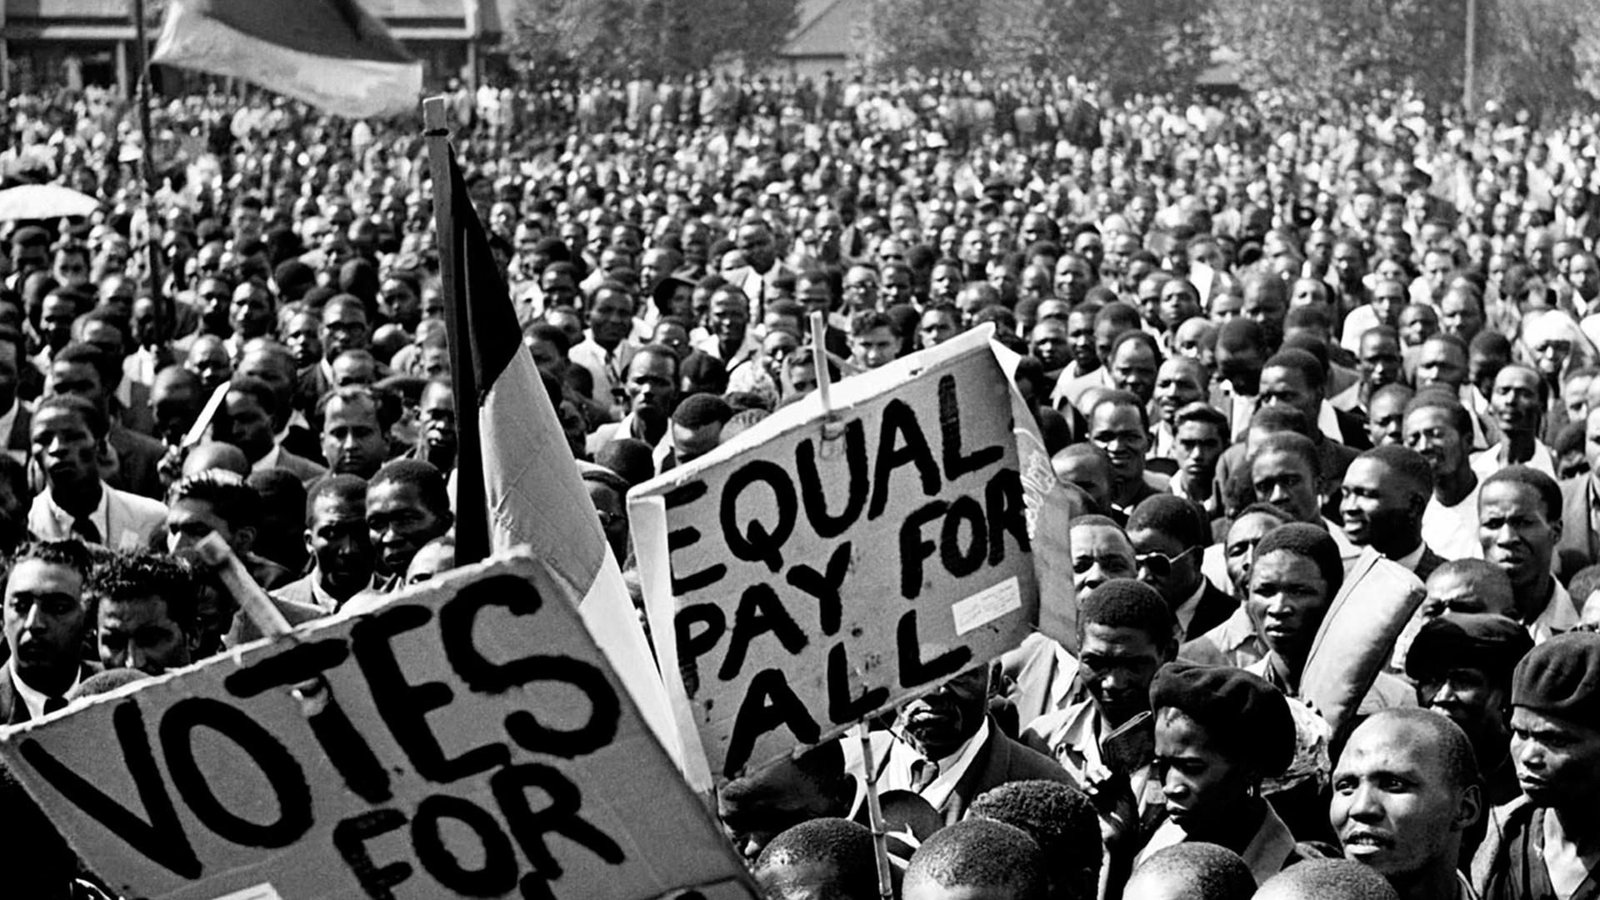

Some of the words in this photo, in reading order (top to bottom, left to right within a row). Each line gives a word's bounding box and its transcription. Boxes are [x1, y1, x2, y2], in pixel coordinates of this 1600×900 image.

[664, 375, 1004, 597] EQUAL
[673, 541, 852, 698] PAY
[900, 468, 1032, 600] FOR
[20, 573, 622, 880] VOTES
[723, 610, 973, 778] ALL
[333, 763, 626, 900] FOR
